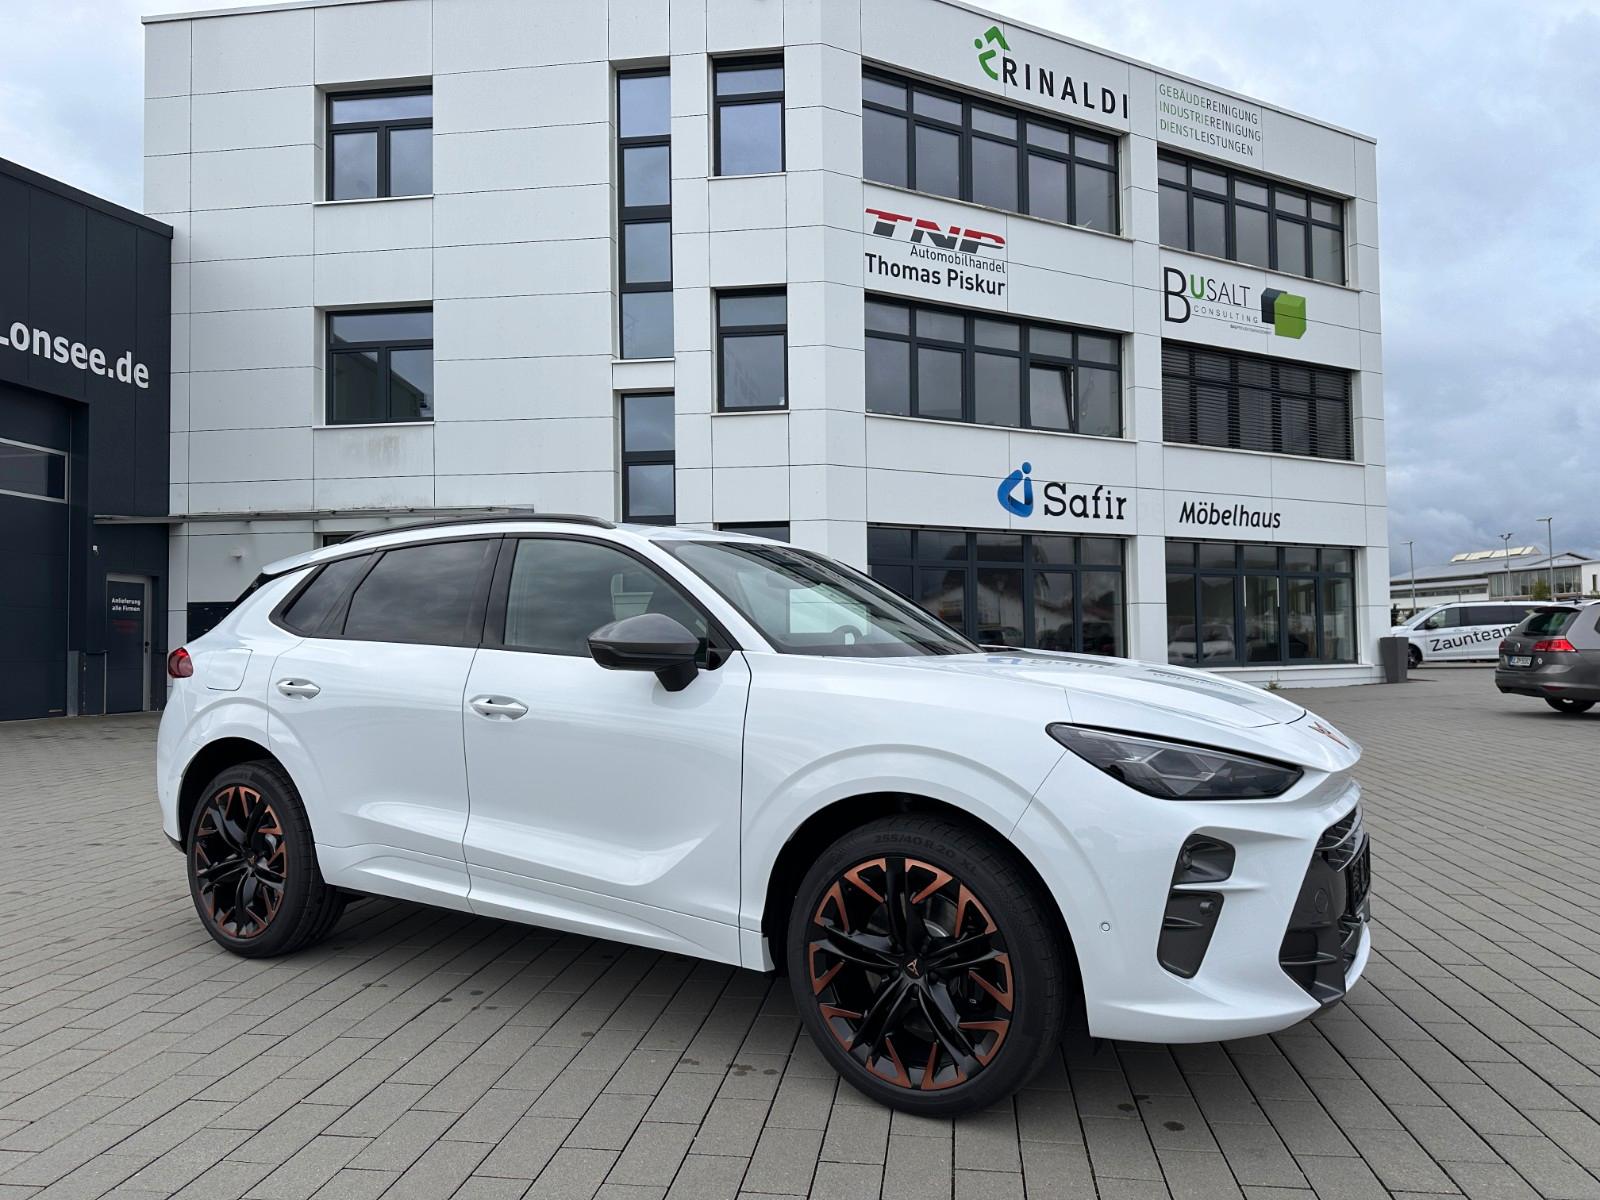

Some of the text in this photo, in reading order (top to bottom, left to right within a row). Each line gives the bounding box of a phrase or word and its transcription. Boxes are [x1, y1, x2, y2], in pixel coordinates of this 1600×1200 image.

[1002, 56, 1128, 119] RINALDI
[1159, 83, 1258, 125] GEBÄUDEREINIGUNG
[1159, 101, 1261, 142] INDUSTRIEREINIGUNG
[1159, 118, 1253, 157] DIENSTLEISTUNGEN
[865, 208, 1006, 254] TNP
[865, 252, 1006, 296] Thomas Piskur
[910, 245, 1006, 274] Automobilhandel
[1163, 266, 1250, 323] BUSALT
[1193, 304, 1258, 324] CONSULTING
[0, 322, 149, 389] onsee.de
[1043, 481, 1127, 520] Safir
[1179, 500, 1281, 529] Möbelhaus
